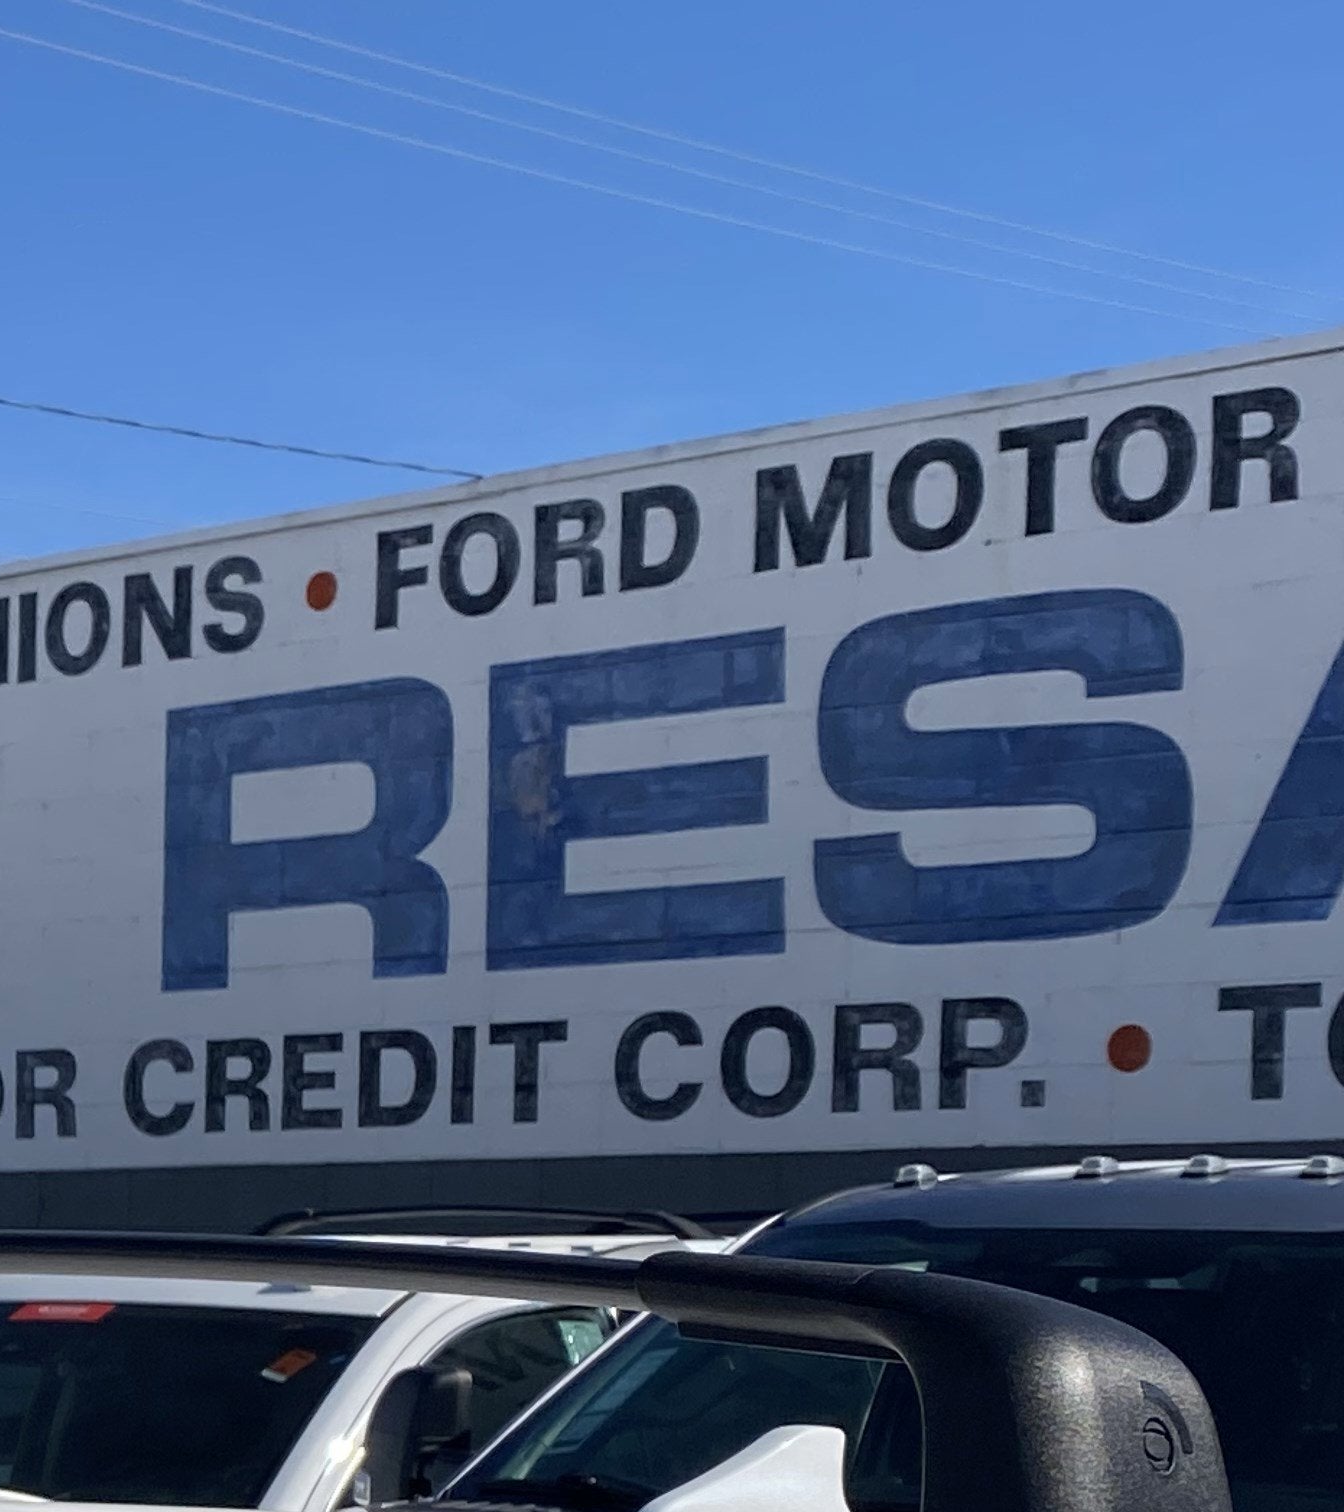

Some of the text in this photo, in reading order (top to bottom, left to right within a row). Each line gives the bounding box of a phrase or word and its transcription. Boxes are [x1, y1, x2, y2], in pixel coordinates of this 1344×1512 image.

[374, 483, 702, 630] FORD
[753, 386, 1301, 573] MOTOR
[123, 1020, 568, 1136] CREDIT
[614, 996, 1047, 1122] CORP.
[1218, 982, 1344, 1100] T
